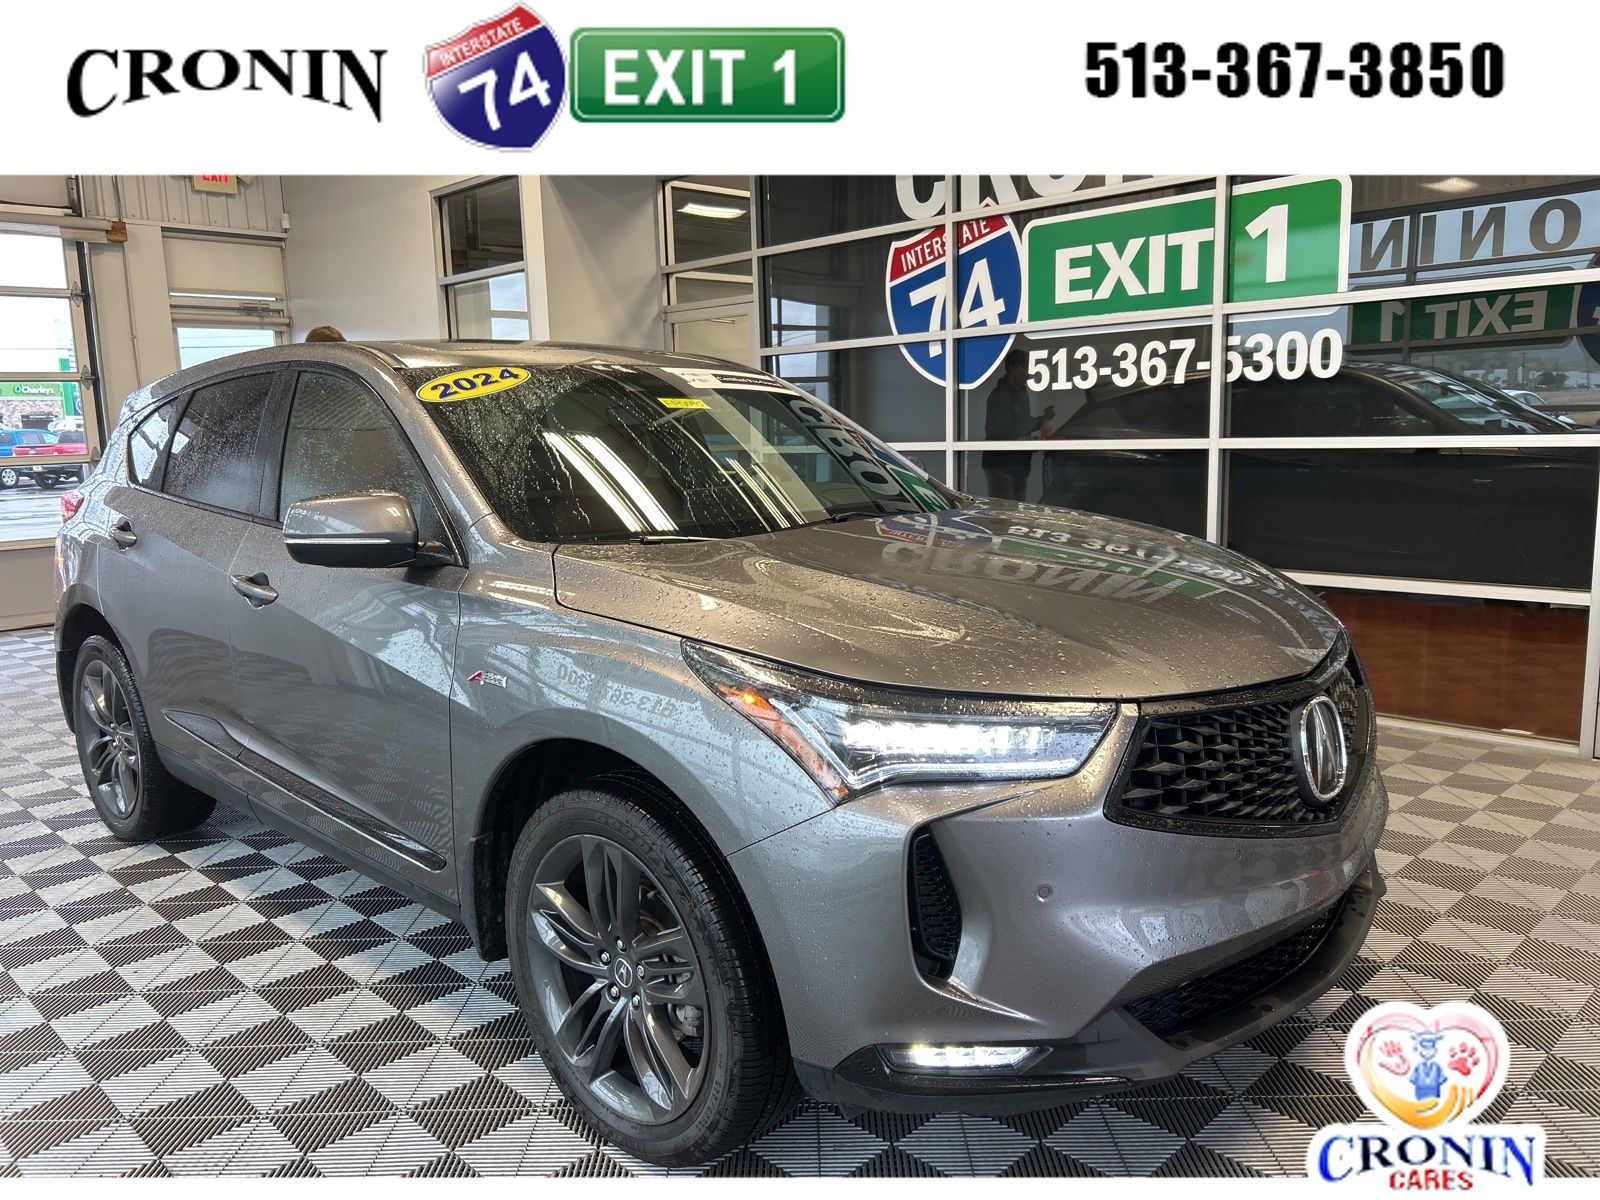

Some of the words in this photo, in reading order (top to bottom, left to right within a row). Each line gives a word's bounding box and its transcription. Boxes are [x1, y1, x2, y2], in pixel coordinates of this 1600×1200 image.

[1054, 226, 1215, 305] EXIT
[1244, 203, 1289, 284] 1
[908, 257, 1007, 359] 74
[430, 367, 522, 400] 2024
[1025, 327, 1344, 393] 513-367-5300
